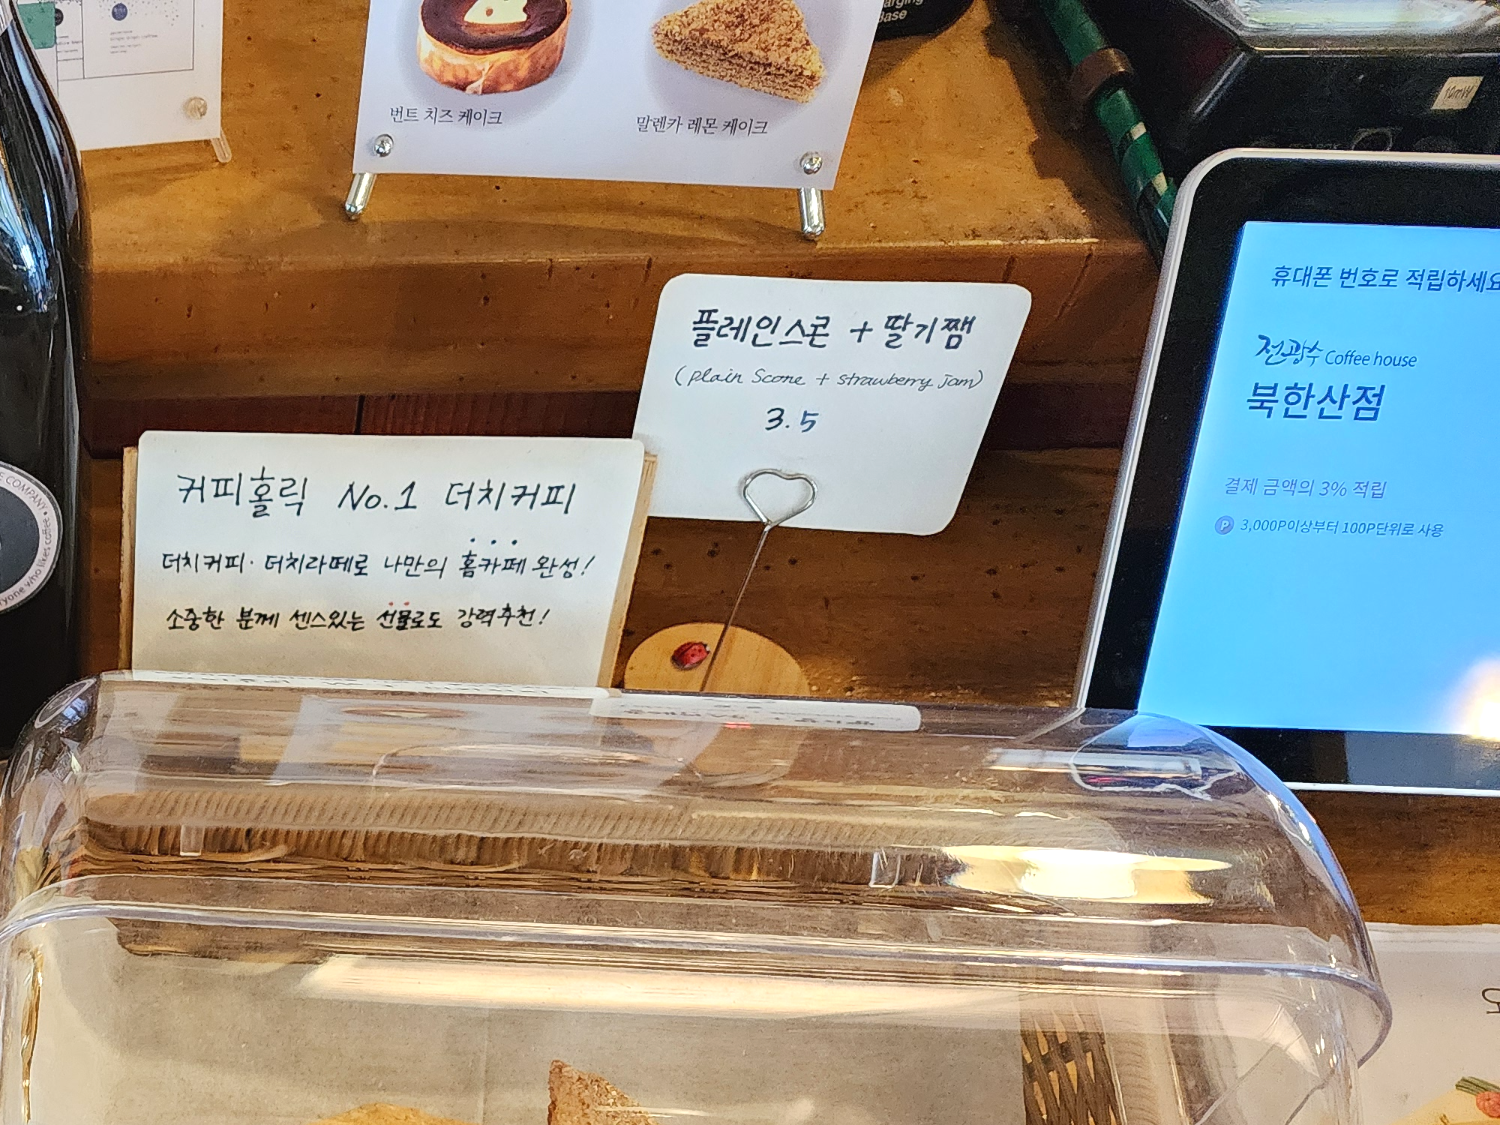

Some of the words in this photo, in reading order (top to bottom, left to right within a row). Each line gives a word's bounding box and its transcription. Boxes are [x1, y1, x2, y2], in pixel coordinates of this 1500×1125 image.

[390, 106, 419, 123] 번트
[424, 107, 453, 125] 치즈
[458, 108, 503, 126] 케이크
[636, 115, 683, 134] 말렌카
[687, 117, 718, 135] 레몬
[722, 118, 768, 136] 케이크
[1271, 264, 1333, 288] 휴대폰
[1339, 266, 1400, 289] 번호로
[1405, 268, 1500, 293] 적립하세요
[692, 307, 831, 349] 플레인스콘
[884, 312, 977, 350] 딸기쨈
[1254, 334, 1323, 367] 전광수
[1324, 350, 1370, 367] Coffee
[1373, 350, 1418, 368] house
[836, 371, 933, 392] strawberry
[1246, 381, 1386, 422] 북한산점
[765, 407, 820, 433] 3.5
[5, 475, 50, 511] COMPANY
[177, 465, 308, 518] 커피홀릭
[337, 480, 419, 513] No.1
[445, 480, 578, 515] 더치커피
[1225, 477, 1258, 496] 결제
[1263, 477, 1315, 497] 금액의
[1319, 480, 1348, 498] 3%
[1352, 480, 1388, 499] 적립
[1240, 518, 1339, 534] 3,000P이상부터
[1341, 520, 1415, 537] 100P단위로
[1417, 522, 1444, 538] 사용
[264, 551, 369, 577] 더치라떼로
[383, 554, 448, 579] 나만의
[458, 549, 526, 579] 홈카페
[531, 554, 596, 580] 완성!
[165, 606, 225, 631] 소중한
[235, 606, 280, 630] 분께
[288, 609, 366, 631] 센스있는
[376, 608, 443, 631] 선물로도
[457, 603, 551, 629] 강력추천!
